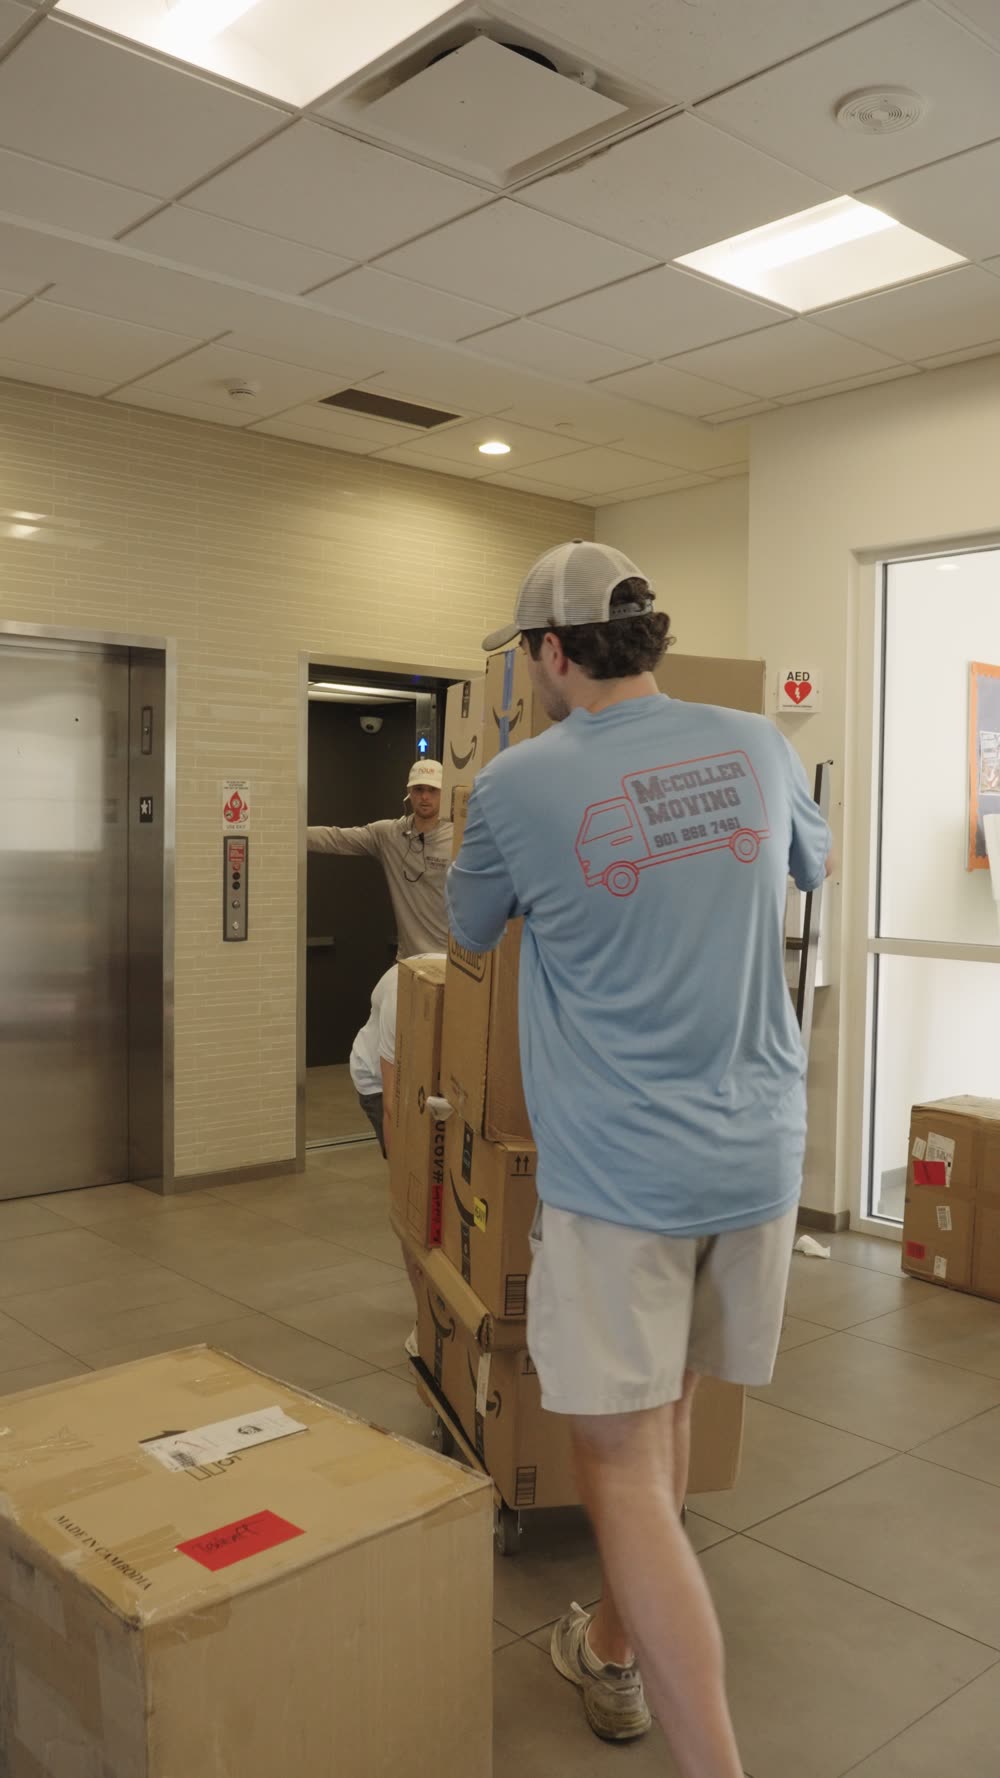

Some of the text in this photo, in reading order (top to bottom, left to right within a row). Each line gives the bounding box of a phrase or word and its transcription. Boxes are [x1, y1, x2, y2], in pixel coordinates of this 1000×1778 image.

[786, 671, 810, 681] AED
[644, 786, 741, 826] MOVING
[654, 831, 678, 848] 901
[681, 824, 708, 841] 262
[56, 1514, 153, 1591] MADE IN CAMBODIA
